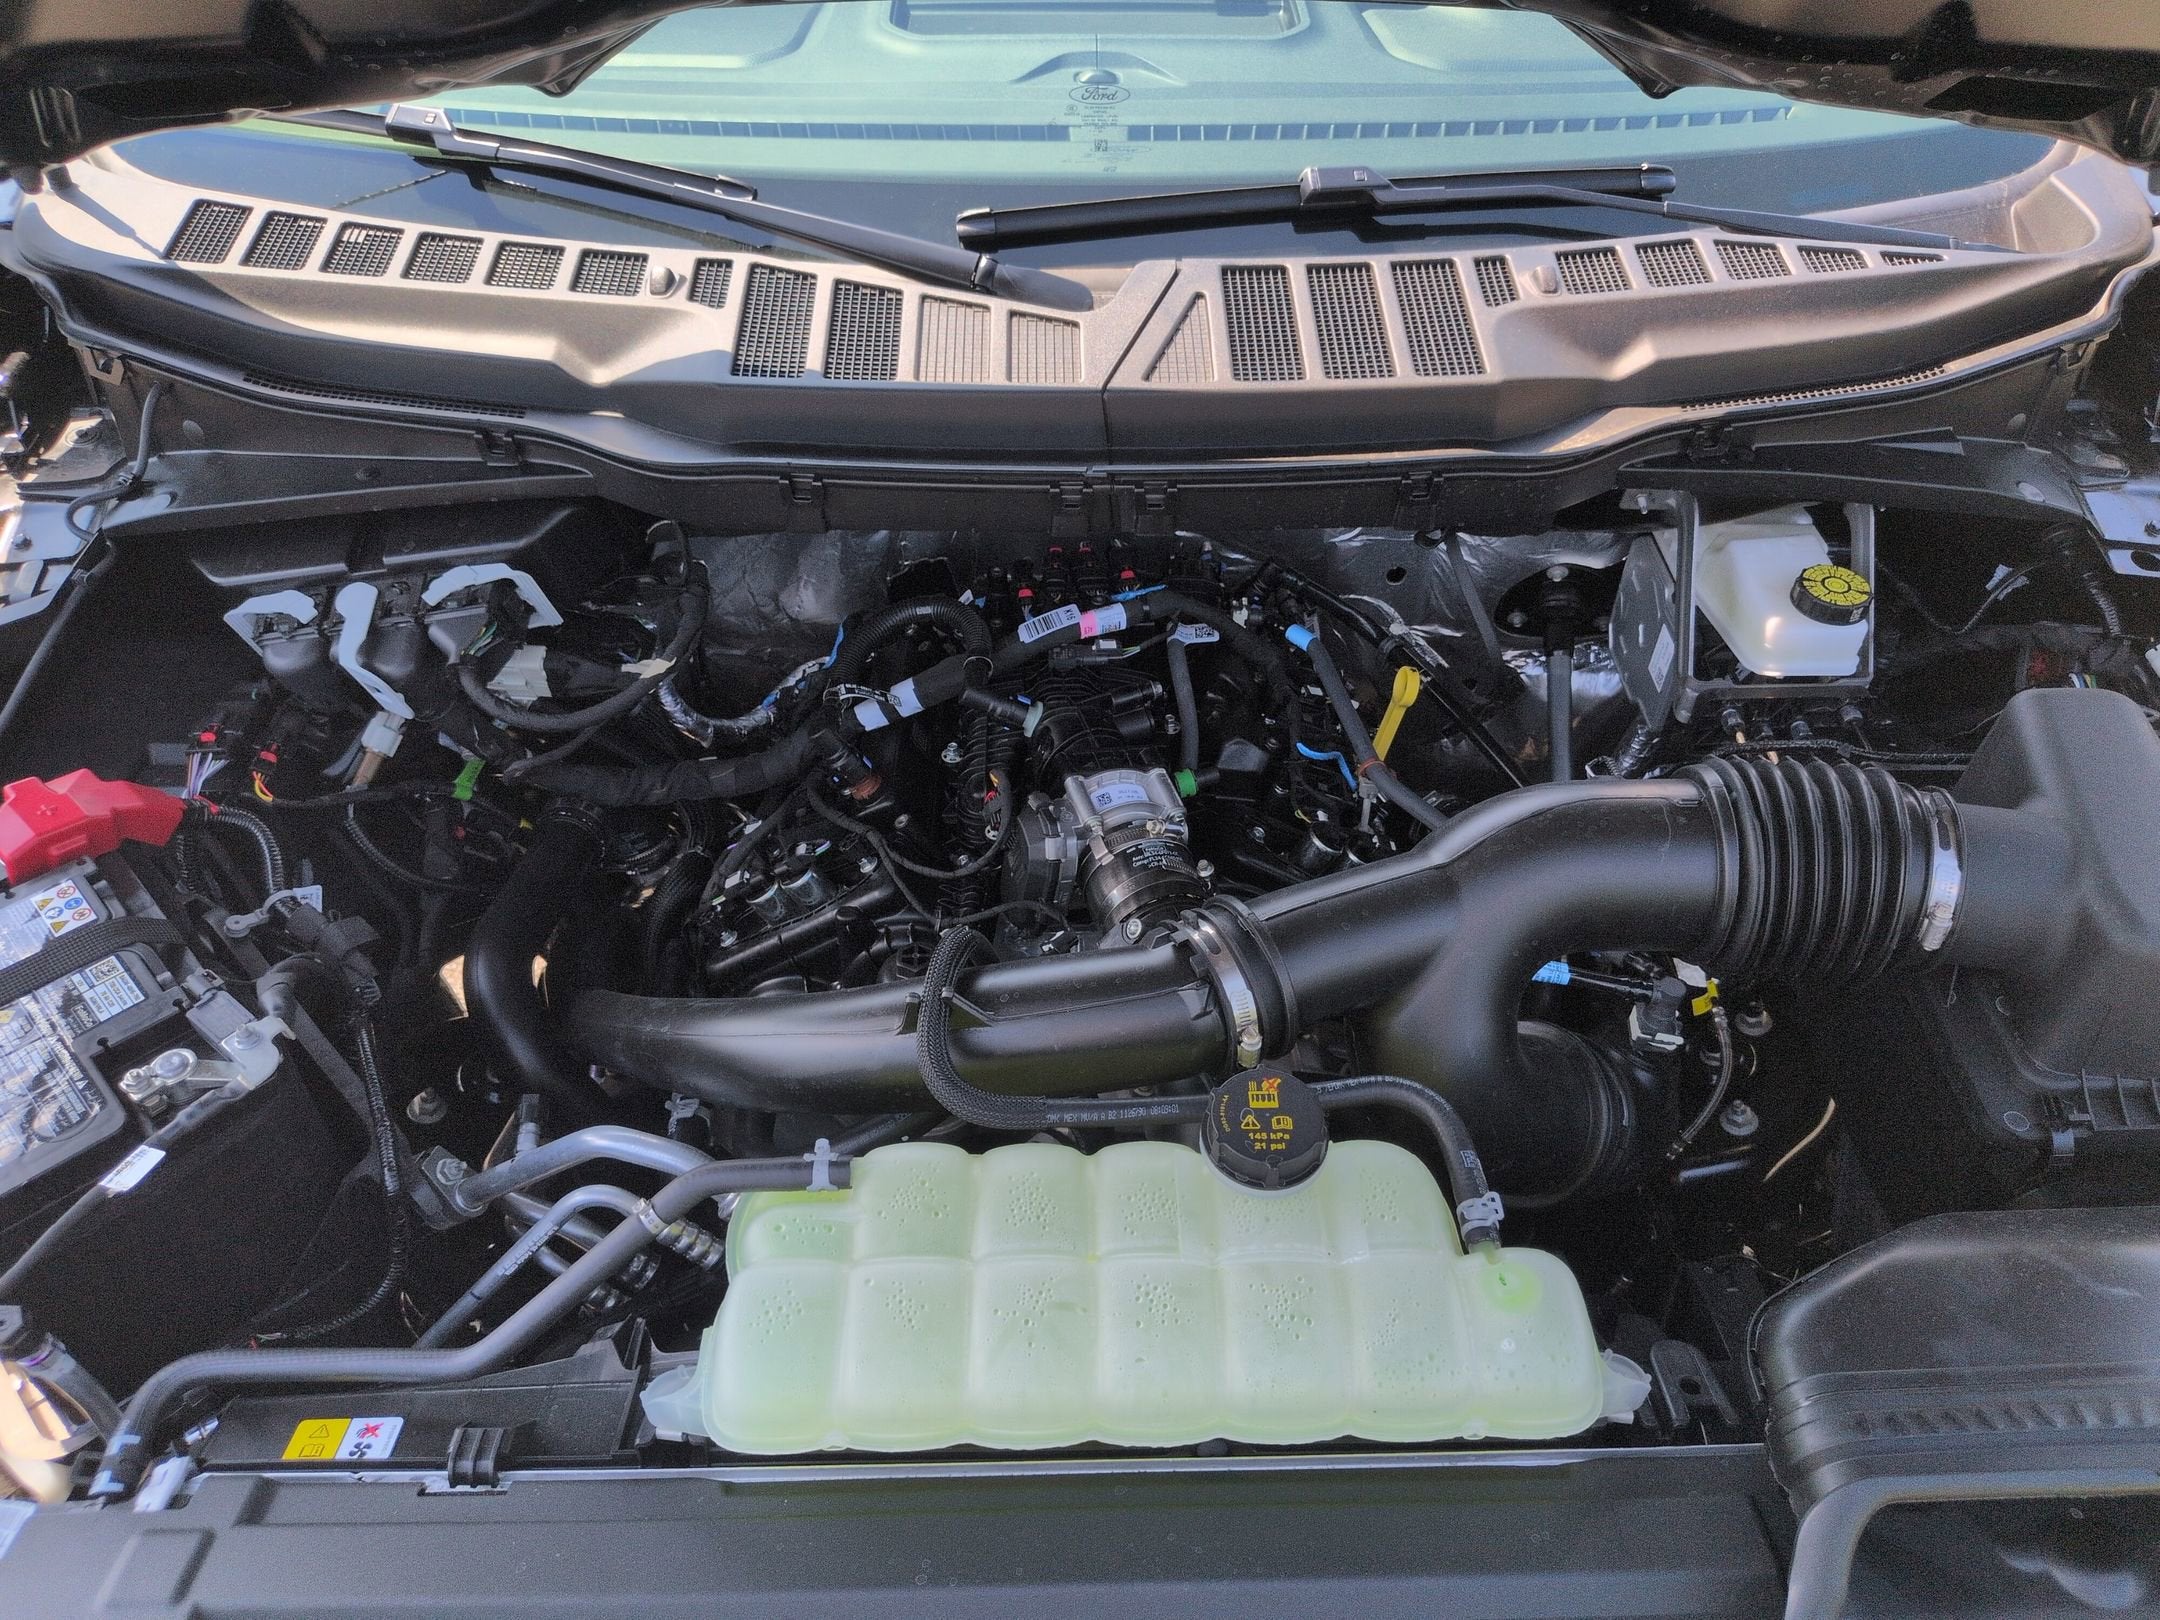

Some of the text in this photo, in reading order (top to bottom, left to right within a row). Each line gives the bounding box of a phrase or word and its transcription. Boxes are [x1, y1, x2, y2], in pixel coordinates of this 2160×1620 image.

[1081, 86, 1118, 101] Ford
[1063, 1113, 1078, 1122] MEX
[1248, 1132, 1290, 1140] 145 kPa
[1254, 1142, 1286, 1151] 21 psi
